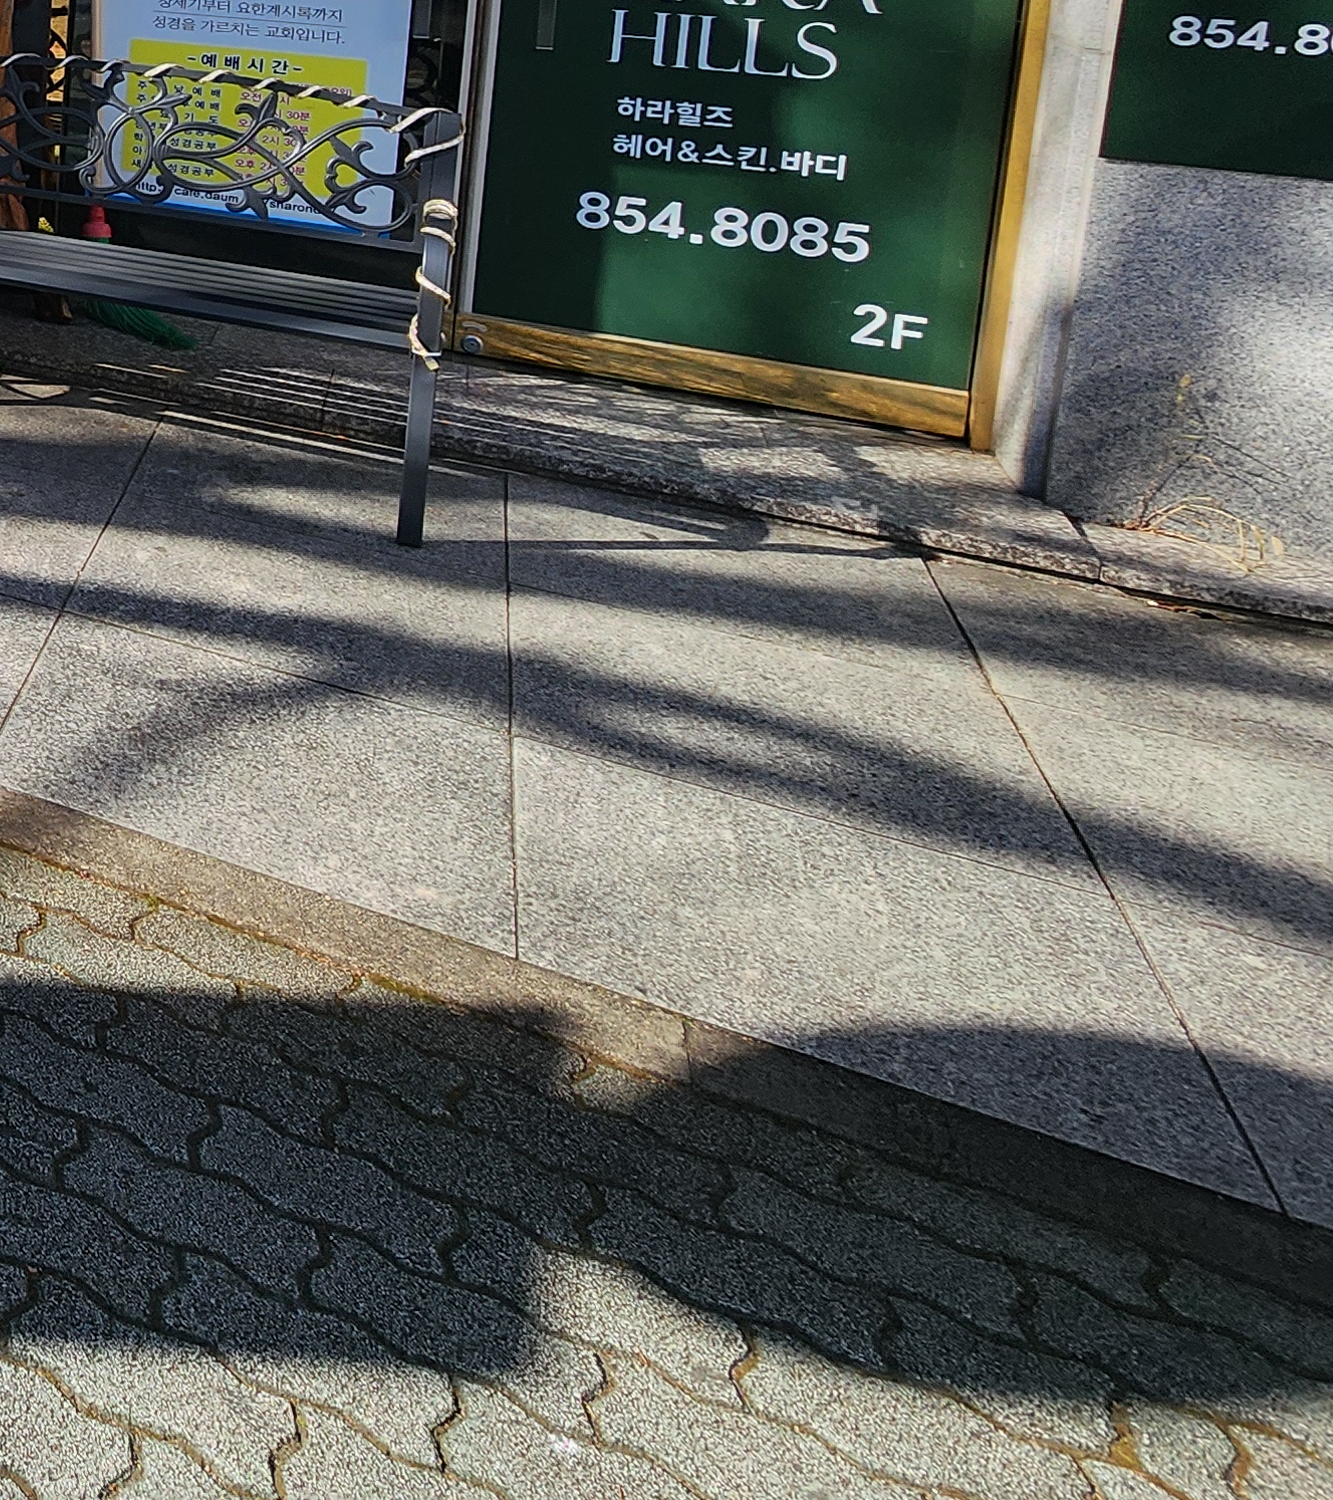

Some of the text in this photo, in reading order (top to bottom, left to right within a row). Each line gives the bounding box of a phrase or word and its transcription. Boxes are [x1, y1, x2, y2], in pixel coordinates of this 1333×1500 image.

[151, 15, 196, 32] 성경을
[200, 19, 260, 37] 가르치는
[235, 1, 343, 23] 요한계시록까지
[606, 8, 838, 80] HILLS
[616, 96, 735, 130] 하라힐즈
[574, 190, 871, 264] 854.8085
[850, 303, 929, 351] 2F
